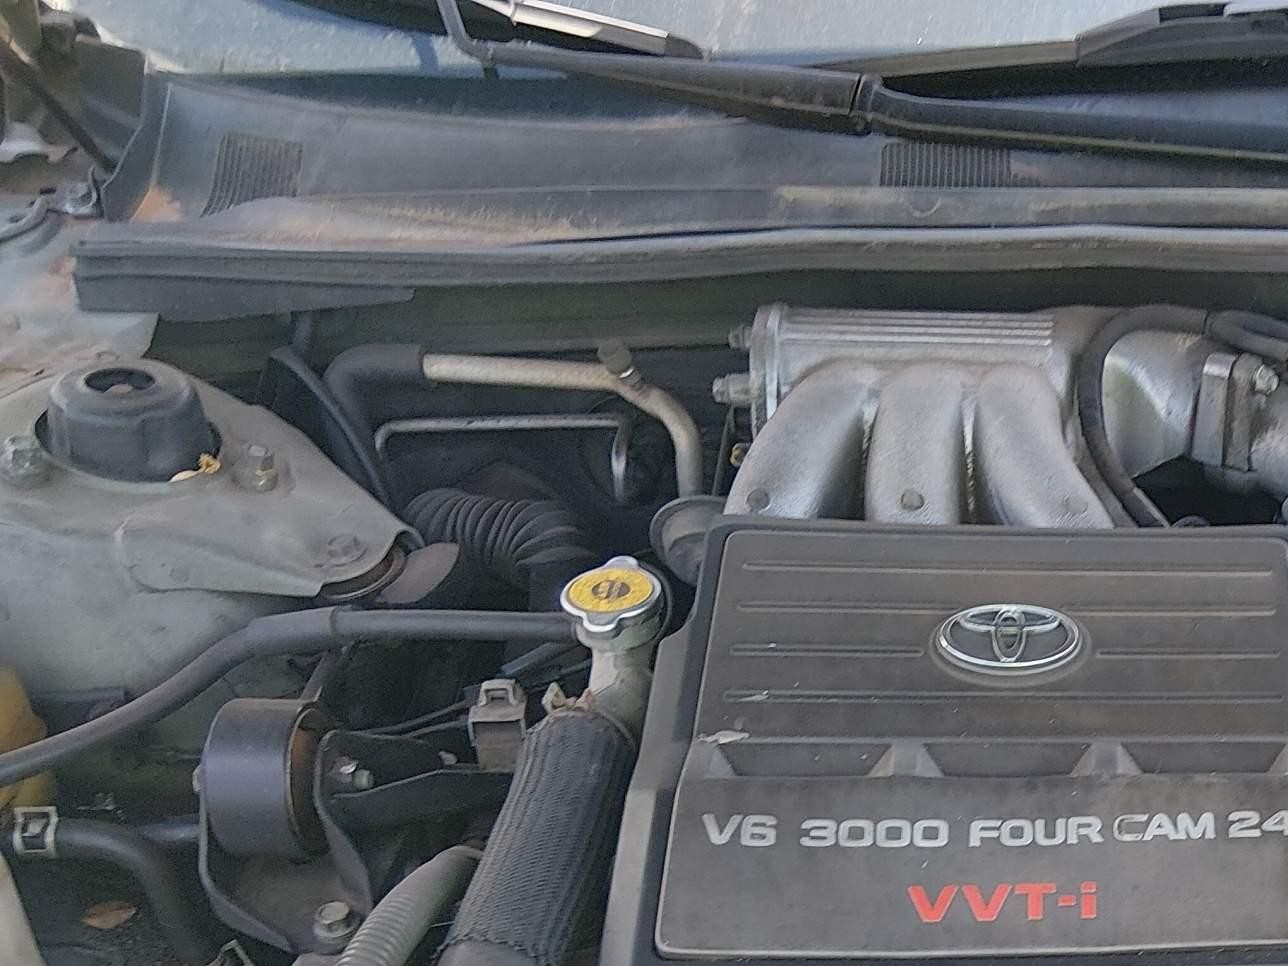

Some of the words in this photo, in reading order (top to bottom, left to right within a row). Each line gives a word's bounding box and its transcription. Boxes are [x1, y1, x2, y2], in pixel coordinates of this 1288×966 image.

[702, 814, 777, 847] V6
[799, 819, 949, 848] 3000
[969, 815, 1103, 847] FOUR
[1113, 812, 1215, 841] CAM
[907, 882, 1098, 922] VVT-i
